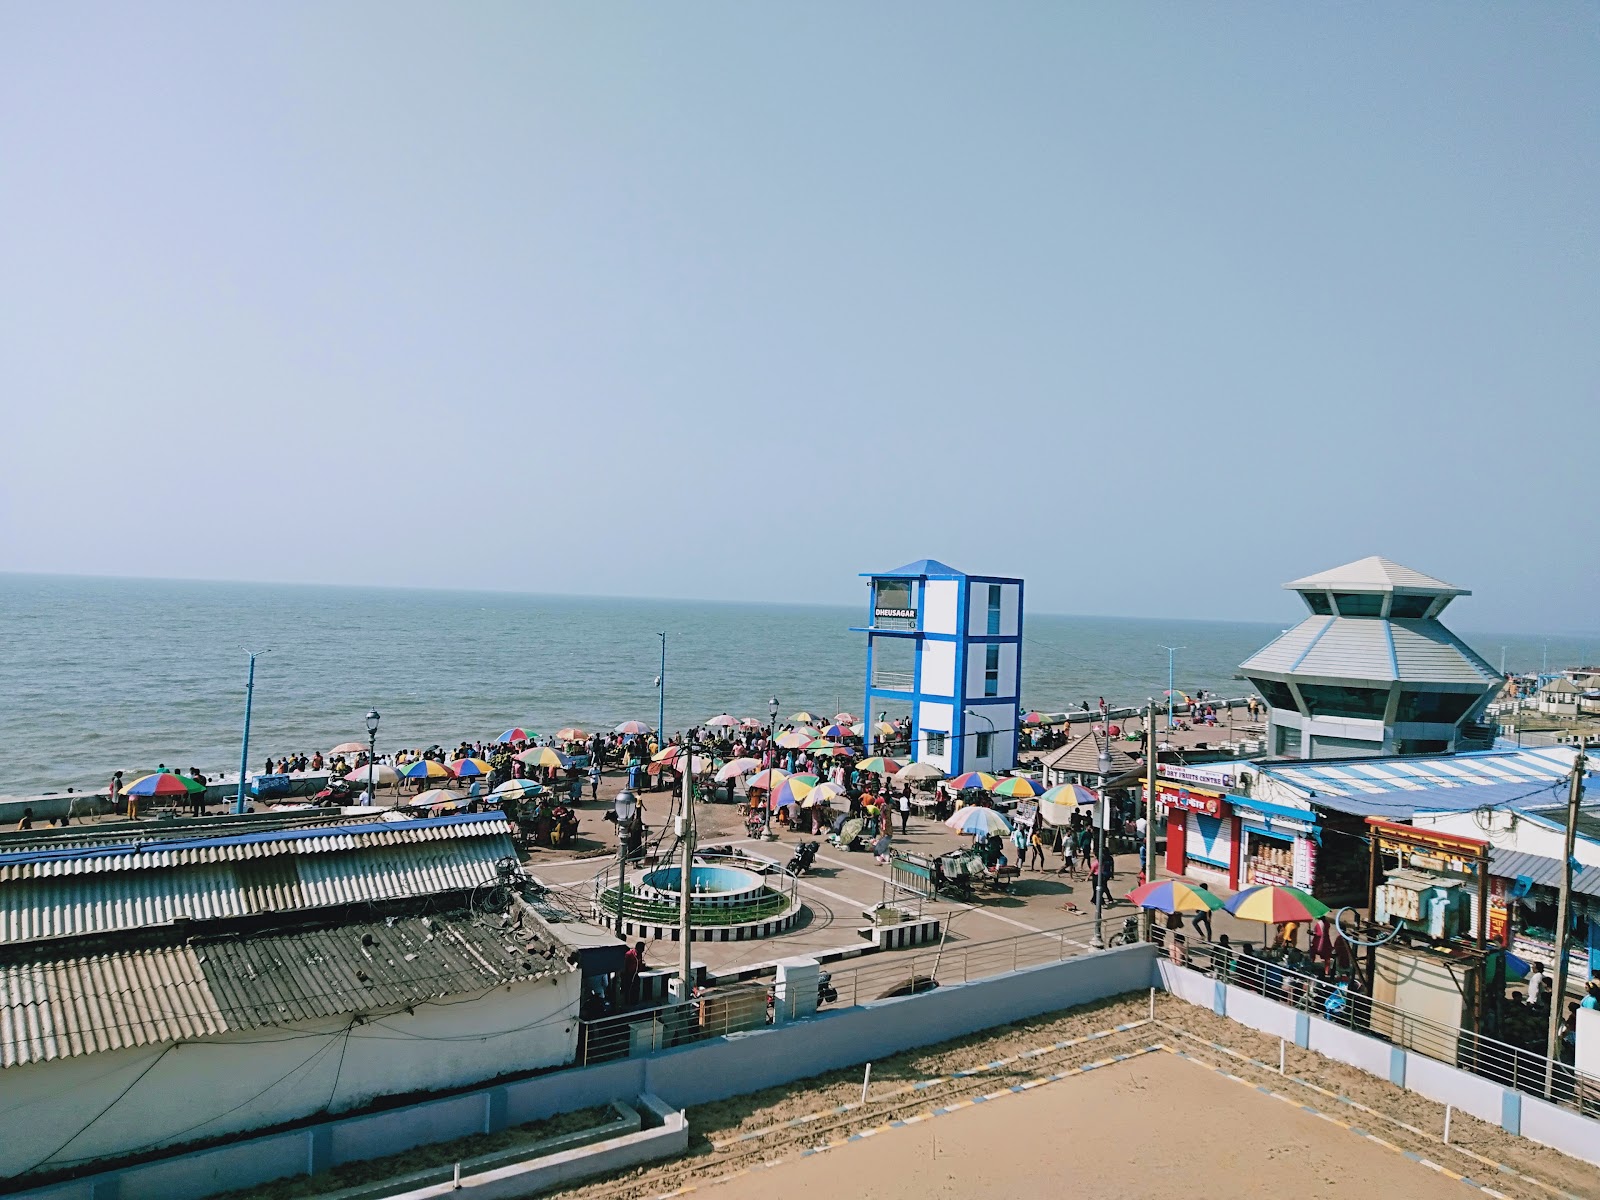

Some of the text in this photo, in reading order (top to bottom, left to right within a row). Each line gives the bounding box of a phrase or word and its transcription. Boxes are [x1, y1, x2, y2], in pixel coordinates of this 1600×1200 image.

[876, 609, 914, 617] DHEUSAGAR
[1179, 771, 1199, 781] FRUITS
[1199, 775, 1221, 784] CENTRE
